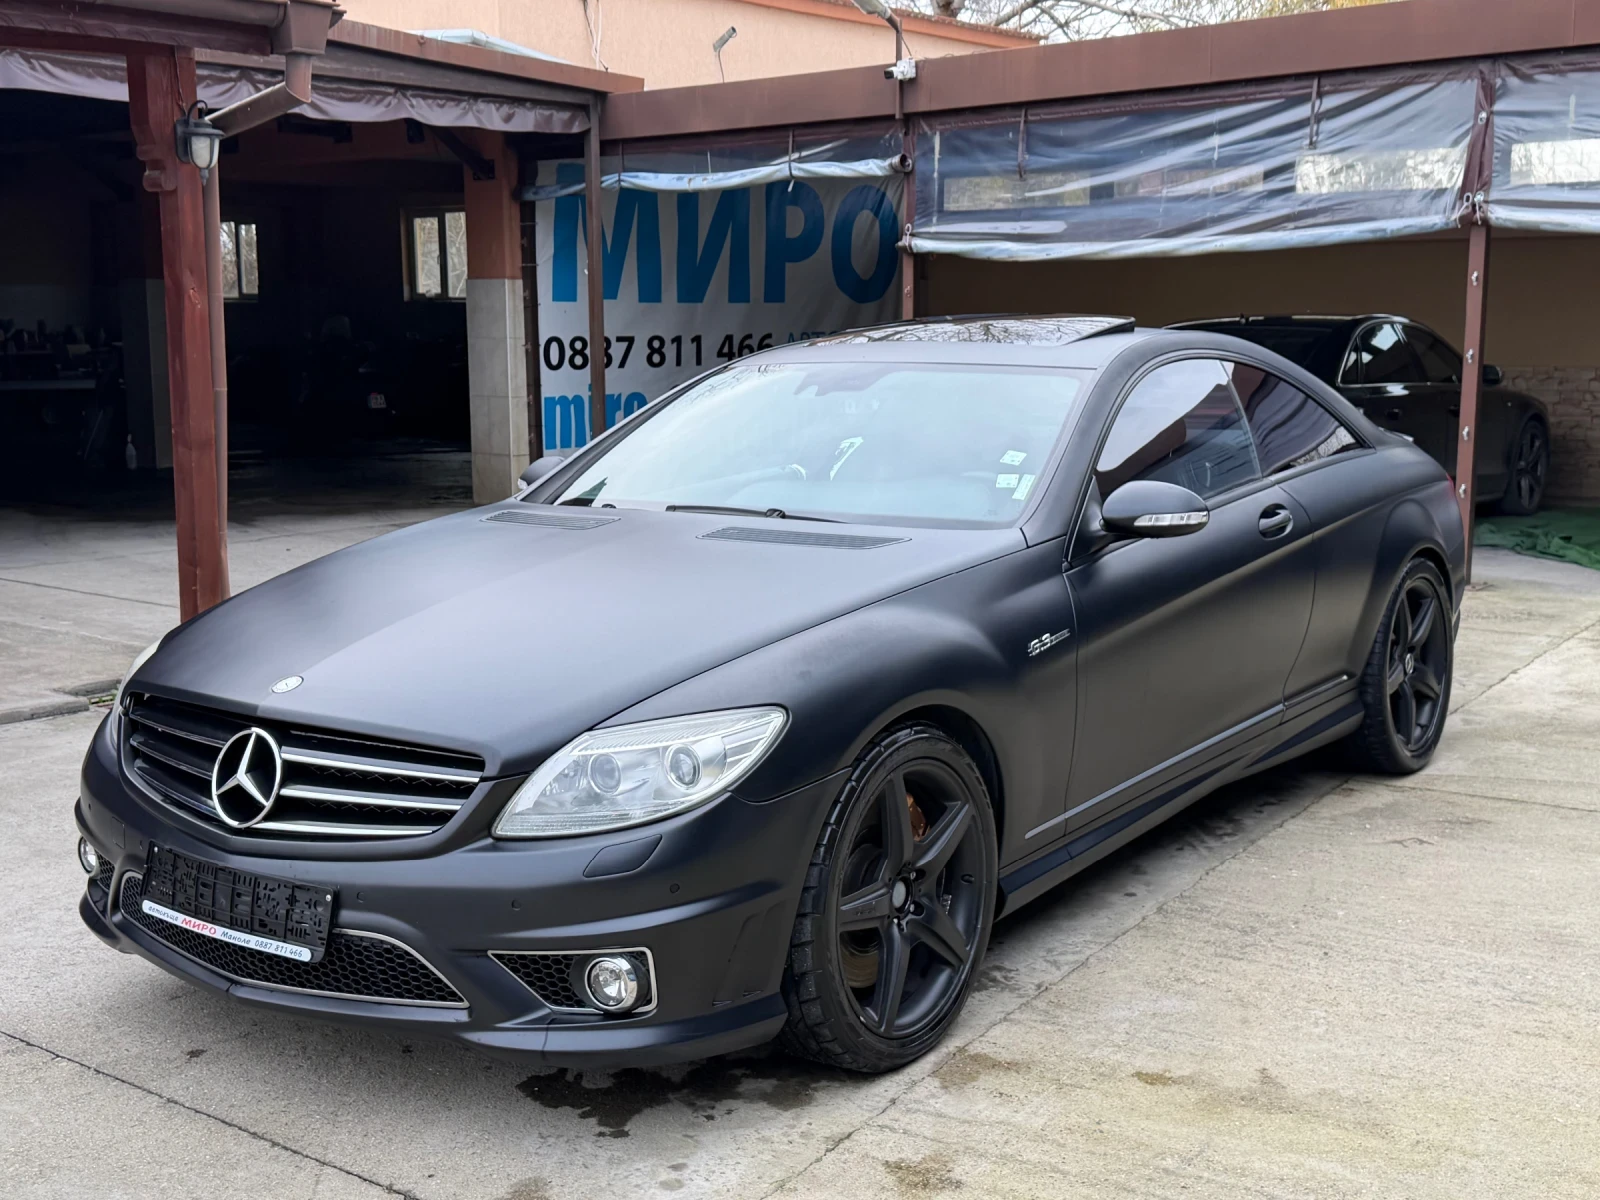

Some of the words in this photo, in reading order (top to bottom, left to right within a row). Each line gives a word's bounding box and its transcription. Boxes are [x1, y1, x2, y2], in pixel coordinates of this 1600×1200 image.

[552, 163, 898, 303] МИРО
[646, 334, 704, 368] 811
[181, 917, 217, 935] МИРО
[254, 939, 273, 950] 0887
[274, 944, 288, 954] 811
[289, 948, 303, 958] 466
